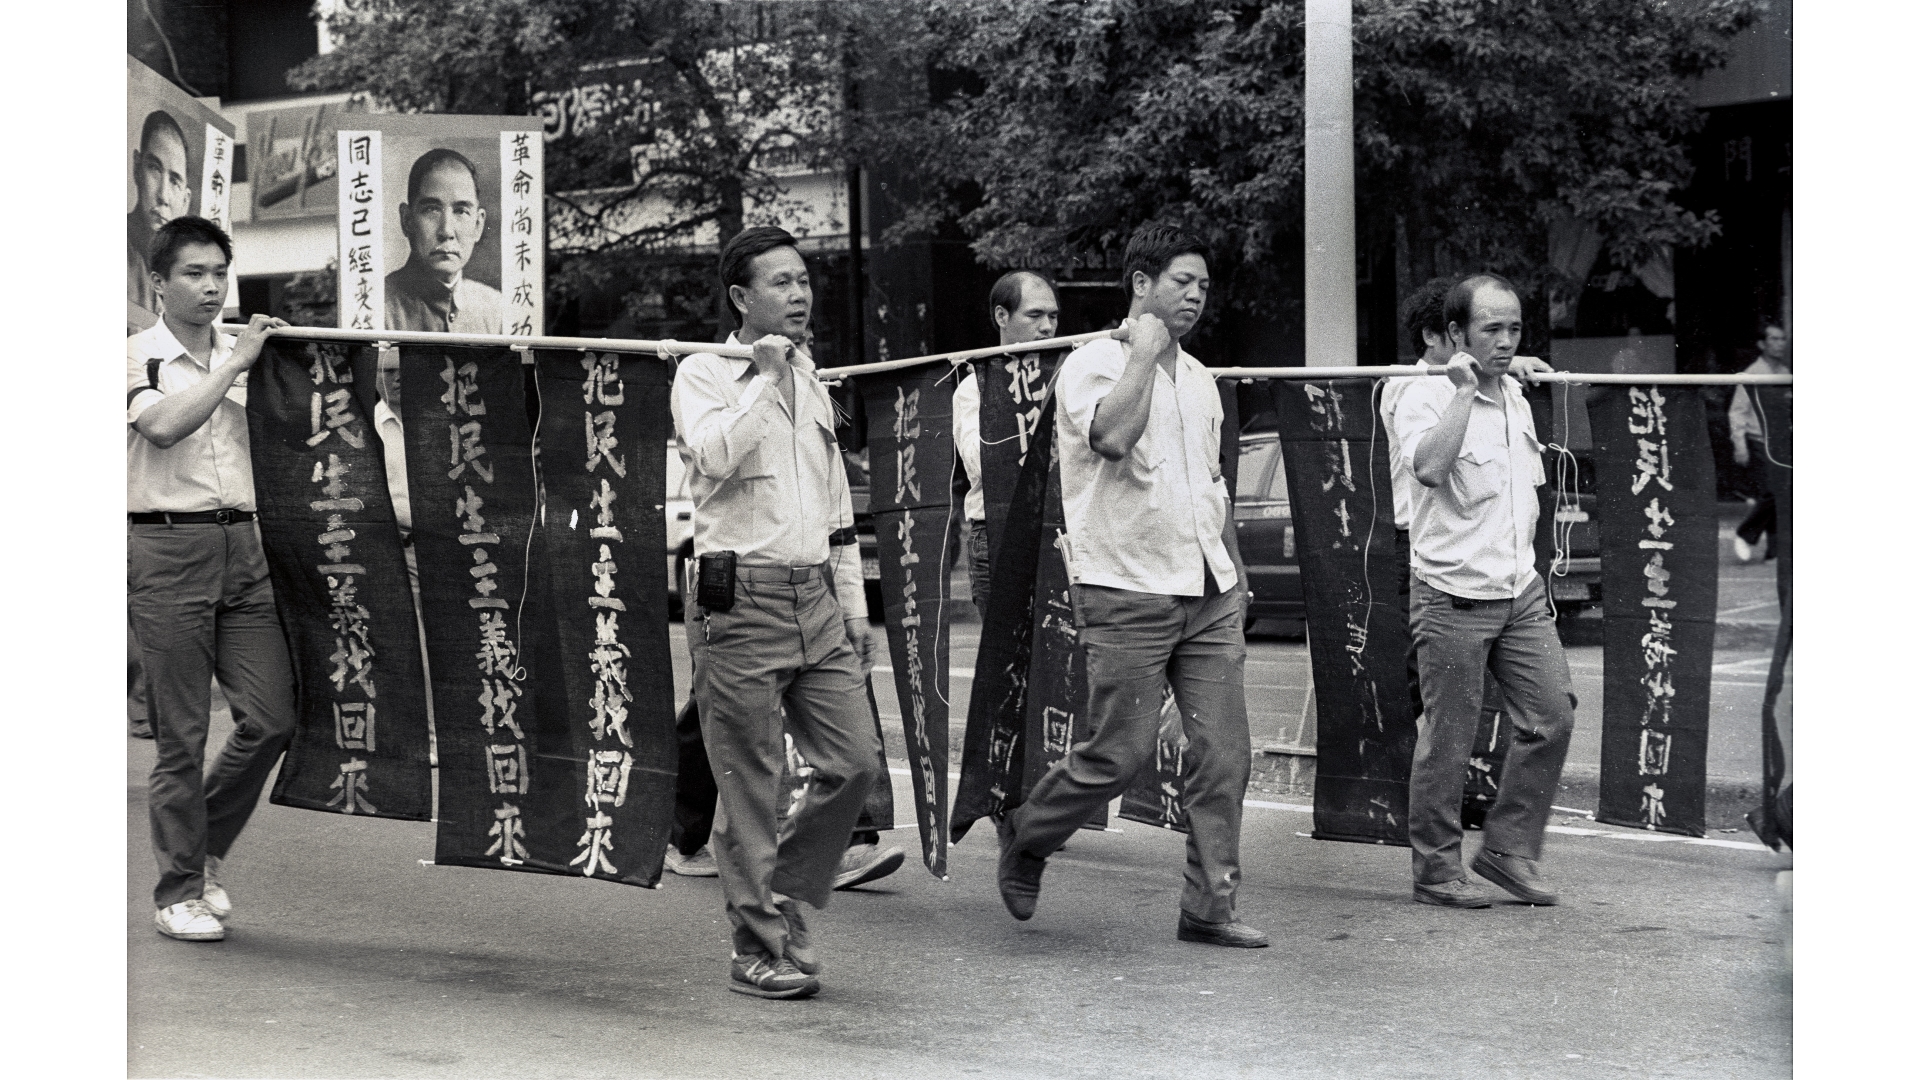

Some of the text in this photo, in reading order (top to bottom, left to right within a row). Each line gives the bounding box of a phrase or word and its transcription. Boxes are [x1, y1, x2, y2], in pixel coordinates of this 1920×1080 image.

[511, 133, 534, 336] 革命尚未成功
[306, 342, 377, 814] 把民生主義找回來
[440, 356, 530, 859] 把民生主義找回來
[570, 352, 633, 877] 把民生主義找回來
